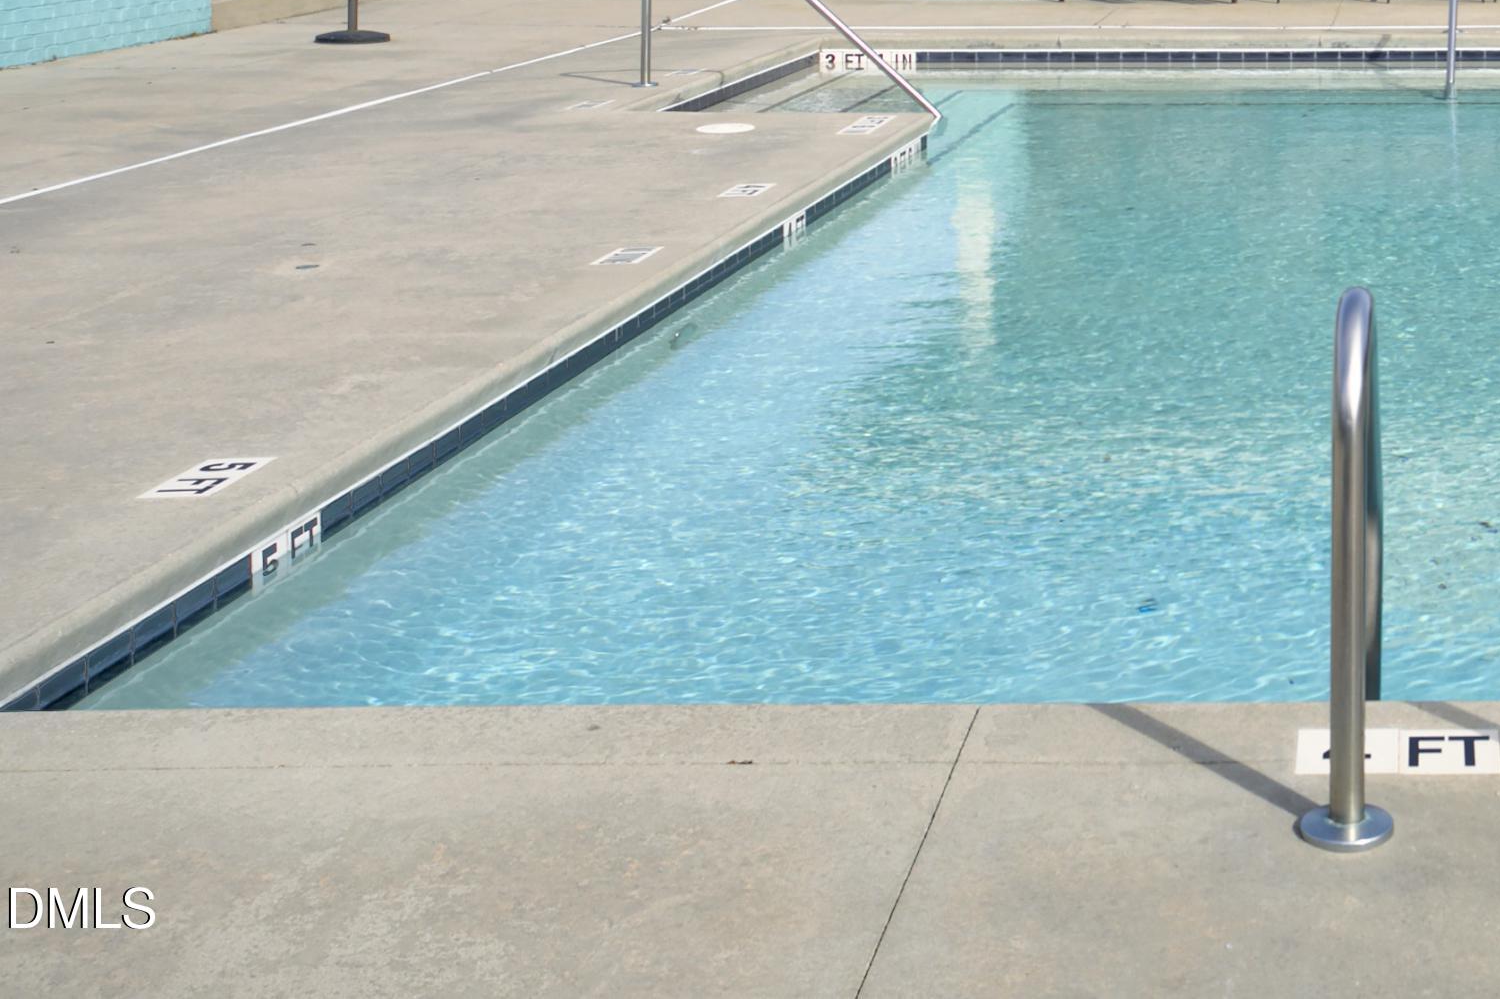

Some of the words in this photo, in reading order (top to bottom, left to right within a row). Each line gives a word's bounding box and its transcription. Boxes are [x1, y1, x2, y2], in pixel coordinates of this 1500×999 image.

[825, 54, 835, 70] 3
[895, 54, 912, 70] IN
[199, 462, 257, 472] 5
[156, 477, 229, 494] FT
[262, 542, 279, 577] 5
[291, 517, 318, 559] FT
[1408, 735, 1490, 767] FT
